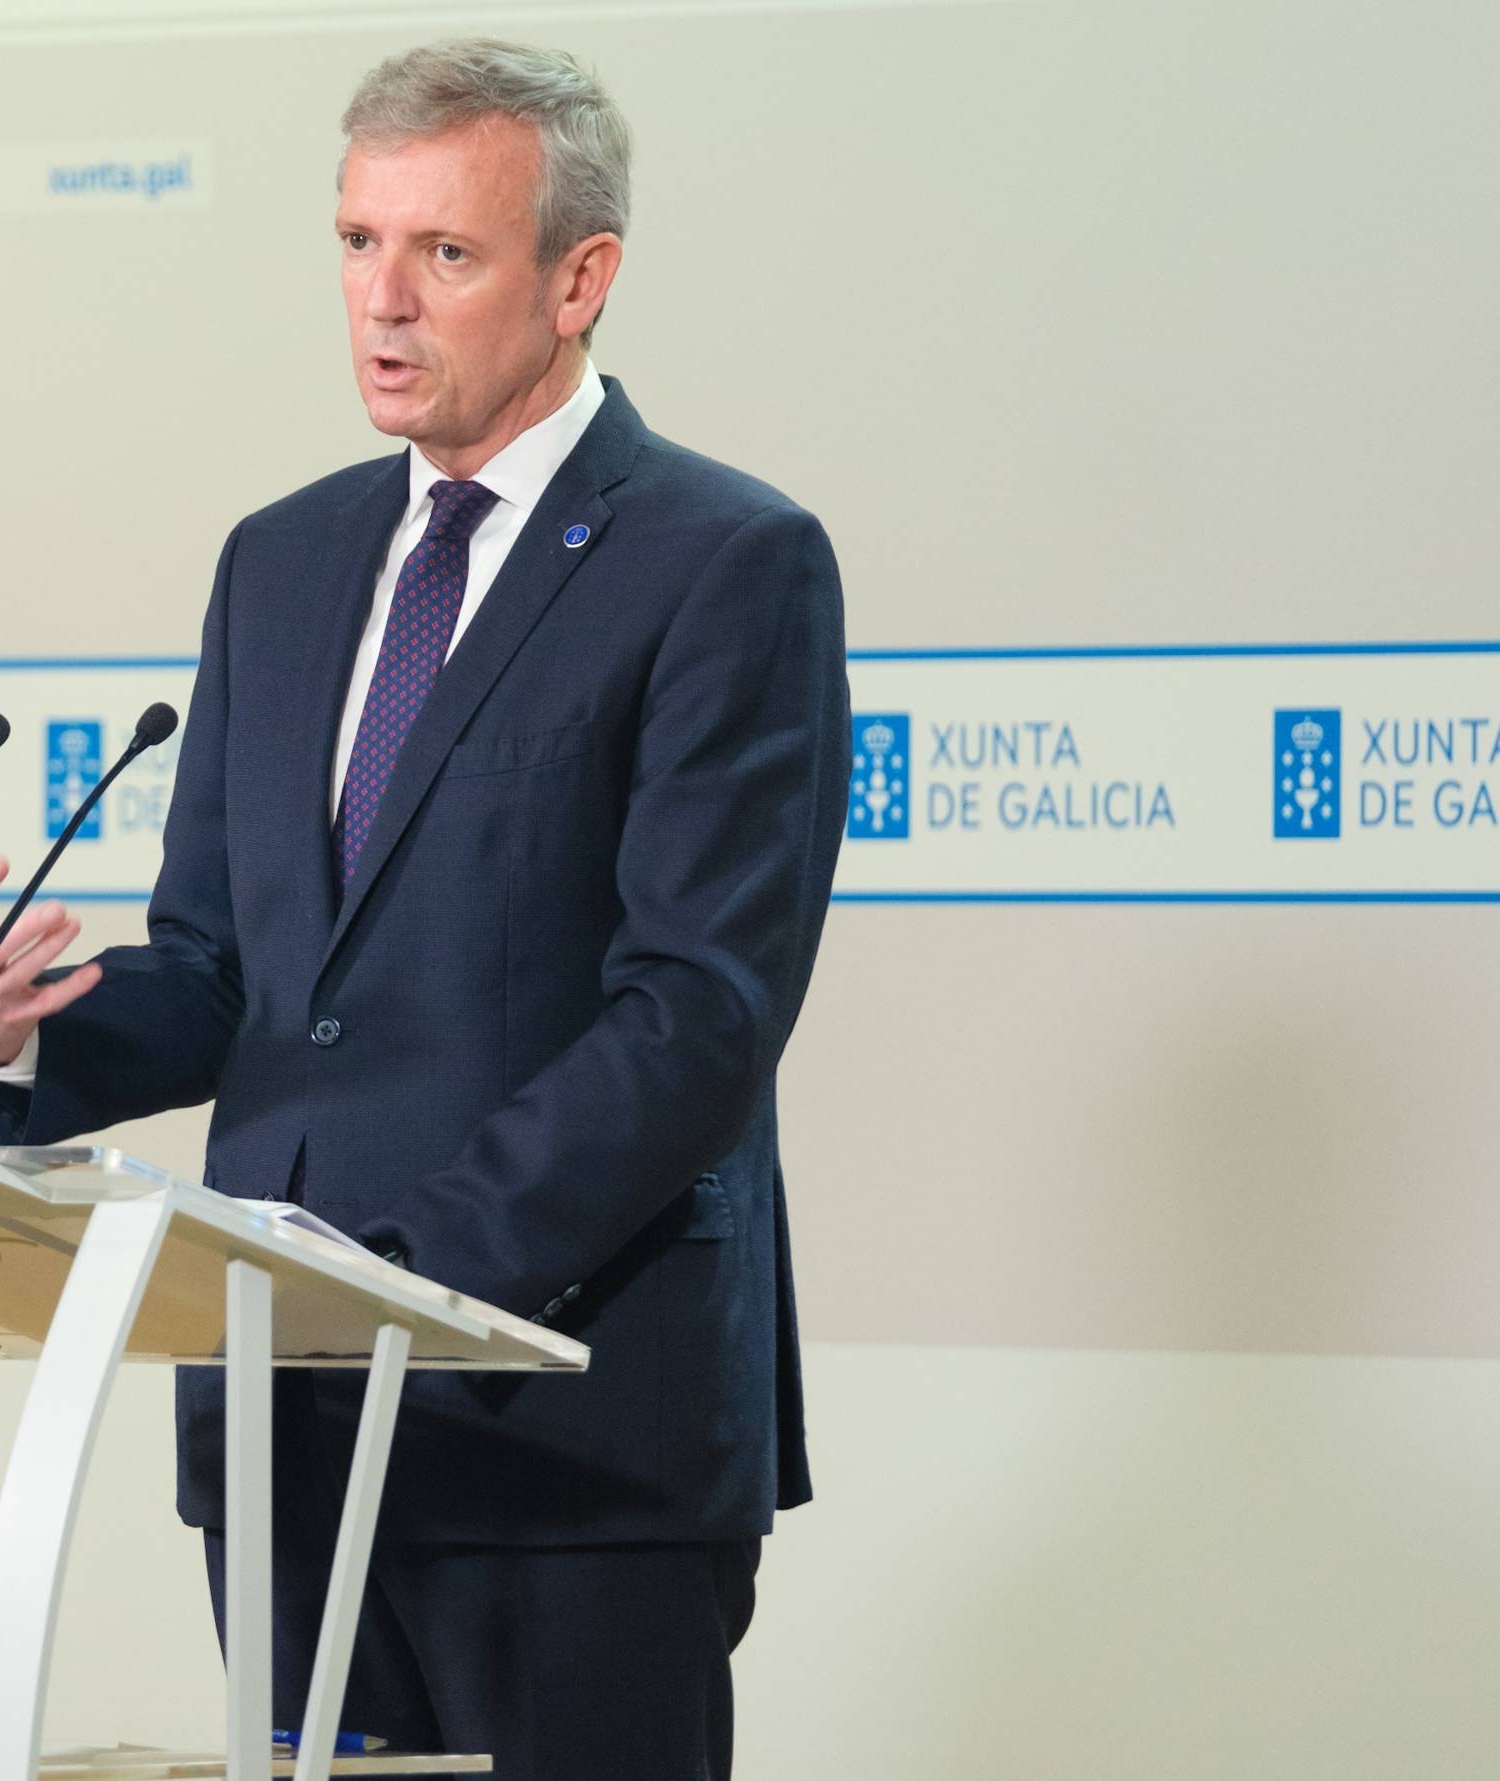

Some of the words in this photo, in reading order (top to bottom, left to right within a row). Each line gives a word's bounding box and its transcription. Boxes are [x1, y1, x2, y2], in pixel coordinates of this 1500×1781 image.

[929, 720, 1082, 770] XUNTA
[927, 782, 981, 831] DE
[997, 780, 1177, 831] GALICIA
[1359, 780, 1415, 828] DE
